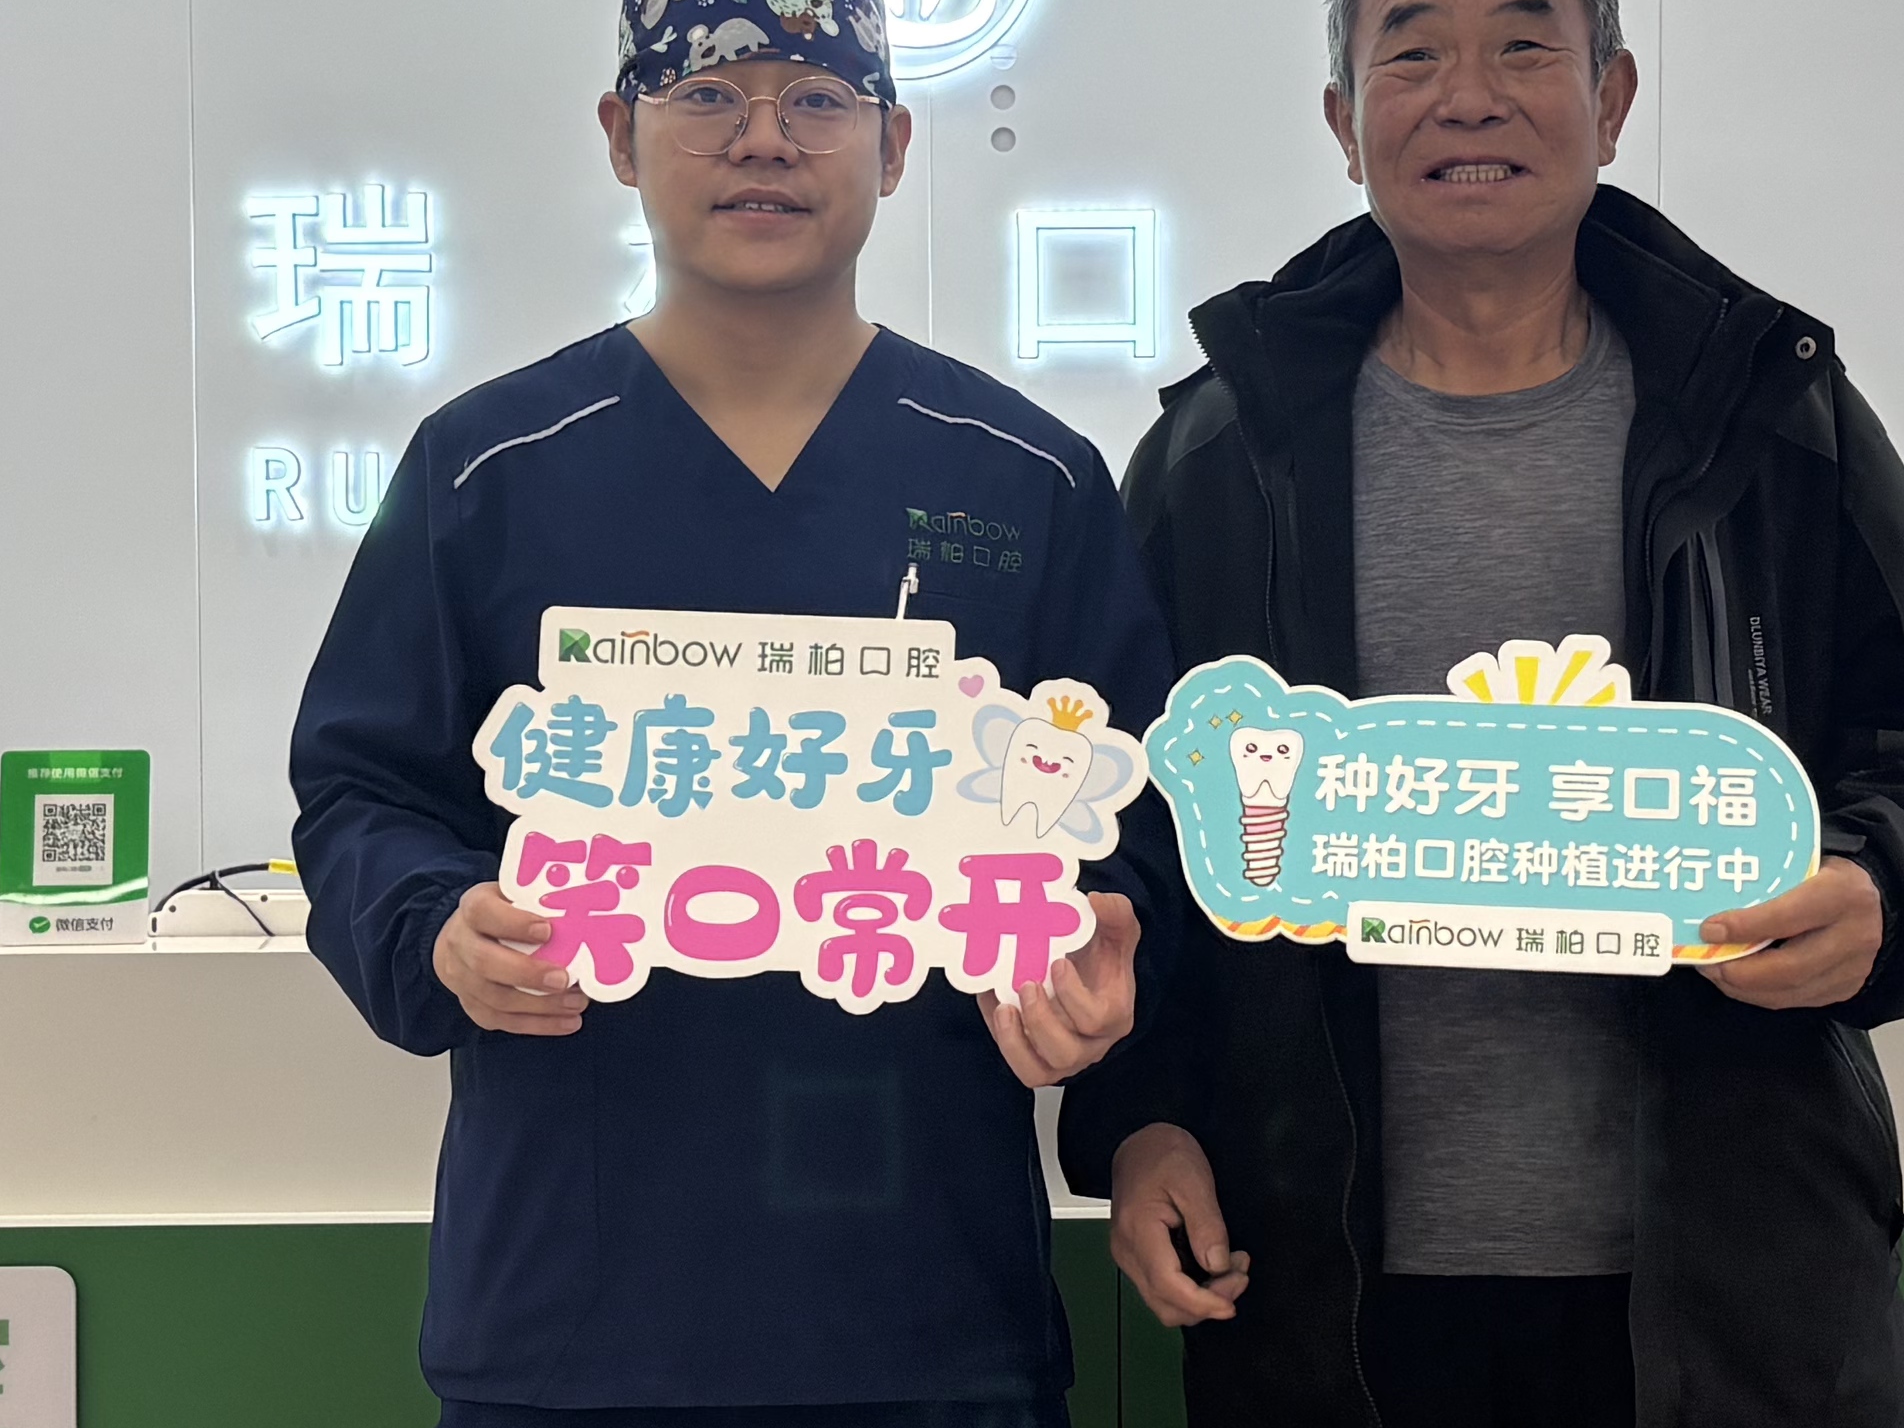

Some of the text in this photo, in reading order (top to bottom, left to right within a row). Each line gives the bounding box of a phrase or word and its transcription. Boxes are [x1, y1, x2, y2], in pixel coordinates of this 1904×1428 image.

[248, 184, 1156, 368] 瑞口
[905, 507, 1021, 541] Rainbow
[906, 537, 1023, 573] 瑞柏口腔
[558, 628, 941, 680] Rainbow 瑞柏口腔
[489, 693, 953, 818] 健康好牙
[1314, 753, 1758, 827] 种好牙 享口福
[1311, 831, 1761, 894] 瑞柏口腔种植进行中
[55, 917, 114, 932] 微信支付
[515, 830, 1081, 999] 笑口常开
[1360, 917, 1661, 958] Rainbow 瑞柏口腔
